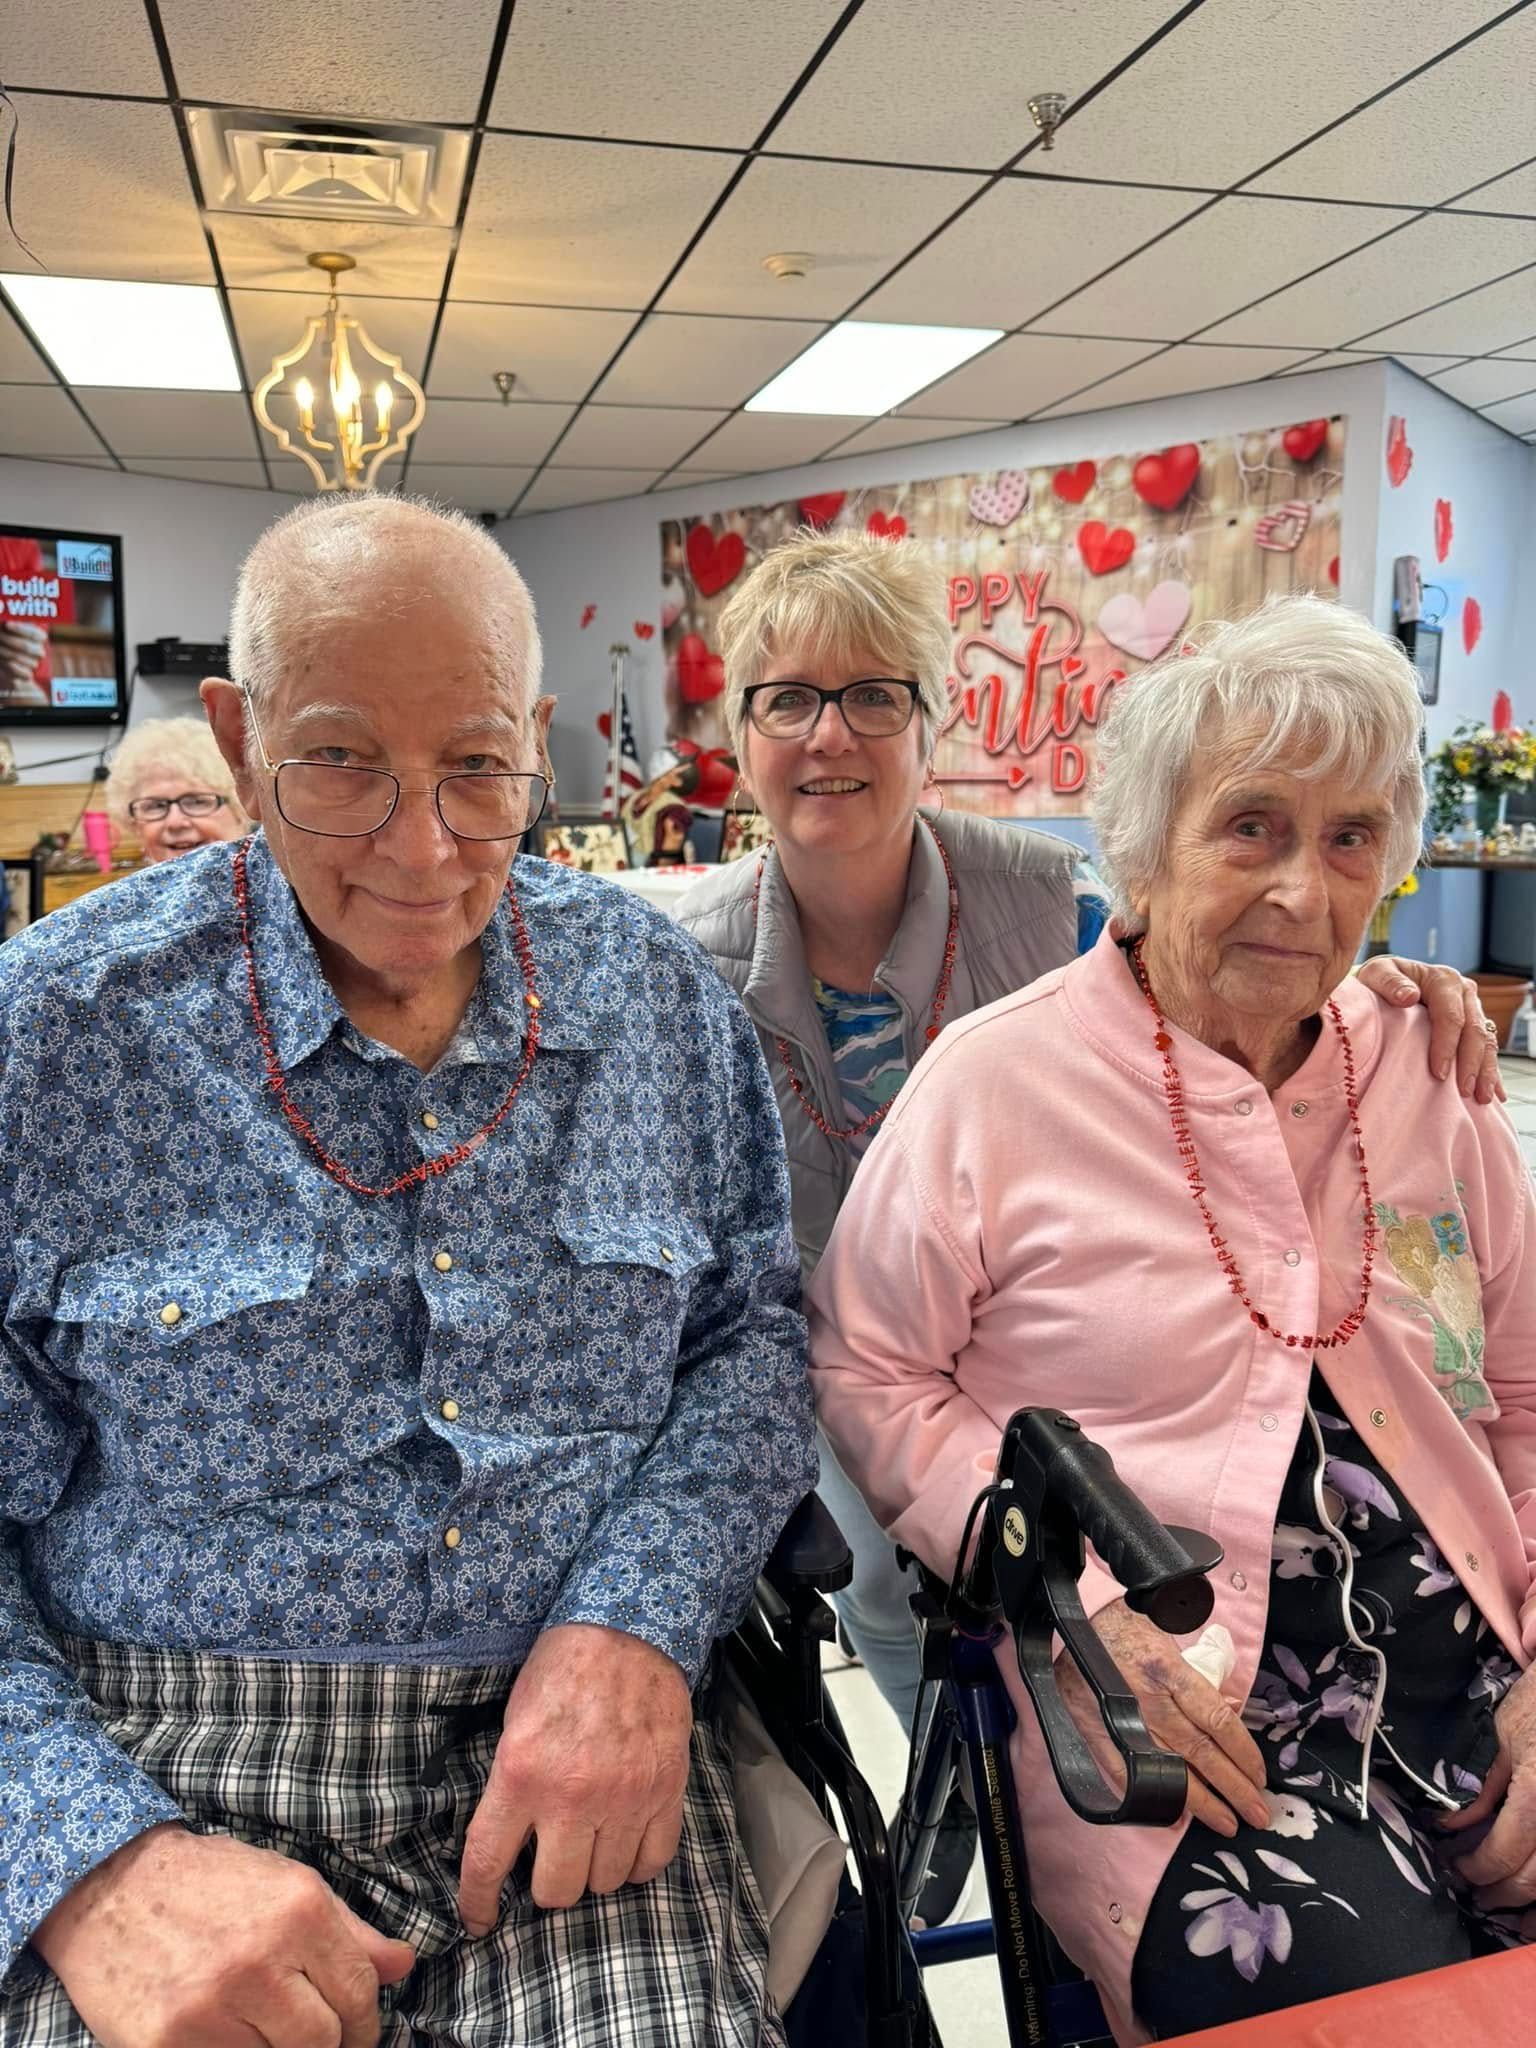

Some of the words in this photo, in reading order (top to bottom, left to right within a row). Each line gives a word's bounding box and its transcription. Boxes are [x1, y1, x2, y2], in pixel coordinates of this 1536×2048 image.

[1, 575, 59, 598] build
[947, 570, 1049, 627] PPY
[7, 596, 58, 618] with
[1005, 1517, 1025, 1545] drive
[991, 1797, 1008, 1838] While
[1000, 1838, 1016, 1889] Rollator
[1008, 1890, 1022, 1929] Move
[1013, 1930, 1027, 1956] Not
[1018, 1958, 1031, 1979] Do
